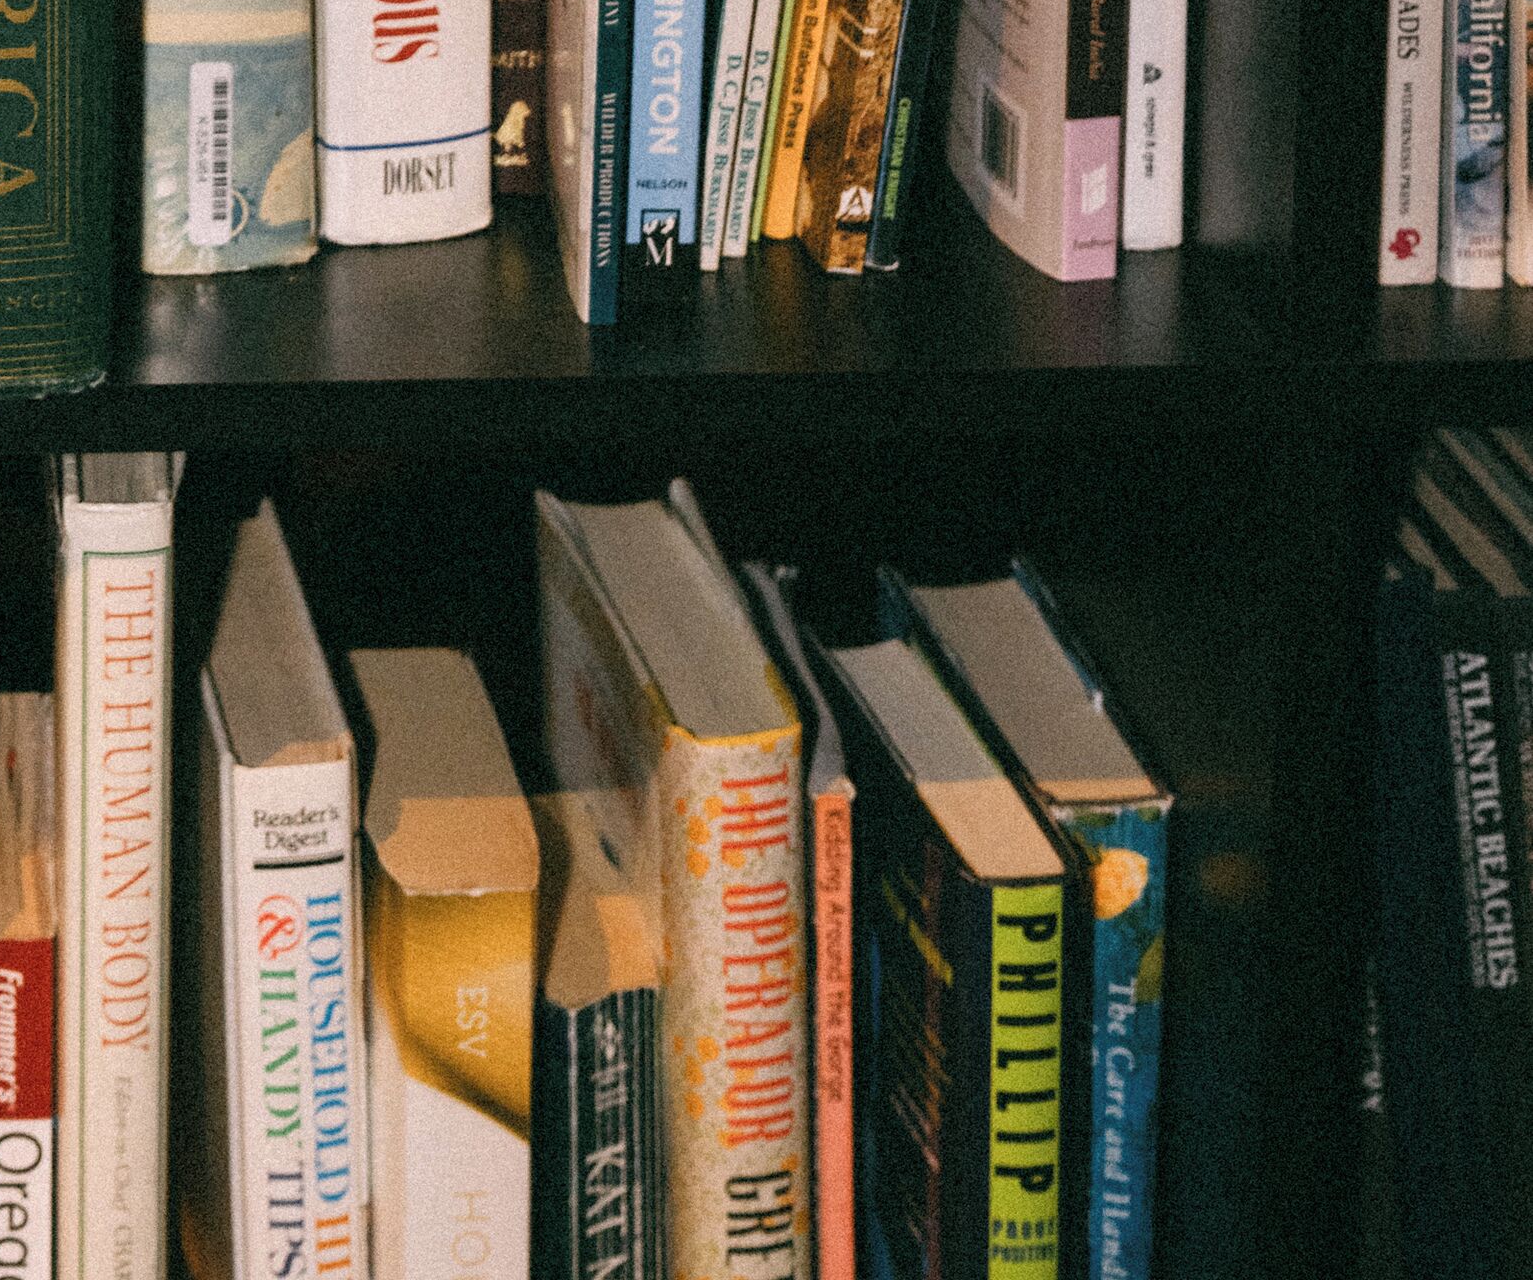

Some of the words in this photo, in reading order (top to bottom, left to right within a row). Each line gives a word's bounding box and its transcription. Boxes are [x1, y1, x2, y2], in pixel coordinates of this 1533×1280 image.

[383, 152, 457, 195] DORSET
[636, 178, 688, 191] NELSON
[783, 102, 804, 149] Press
[595, 157, 615, 269] PRODUCTIONS
[103, 569, 155, 681] THE
[1458, 650, 1503, 826] ATLANTIC
[101, 698, 153, 902] HUMAN
[253, 806, 340, 830] Reader's
[264, 825, 329, 852] Digest
[721, 763, 790, 862] THE
[1475, 831, 1519, 991] BEACHES
[101, 921, 151, 1052] BODY
[722, 881, 795, 1146] OPERATOR
[258, 968, 304, 1144] HANDY
[307, 892, 352, 1203] HOUSEHOLD
[995, 911, 1058, 1194] PHILLIP
